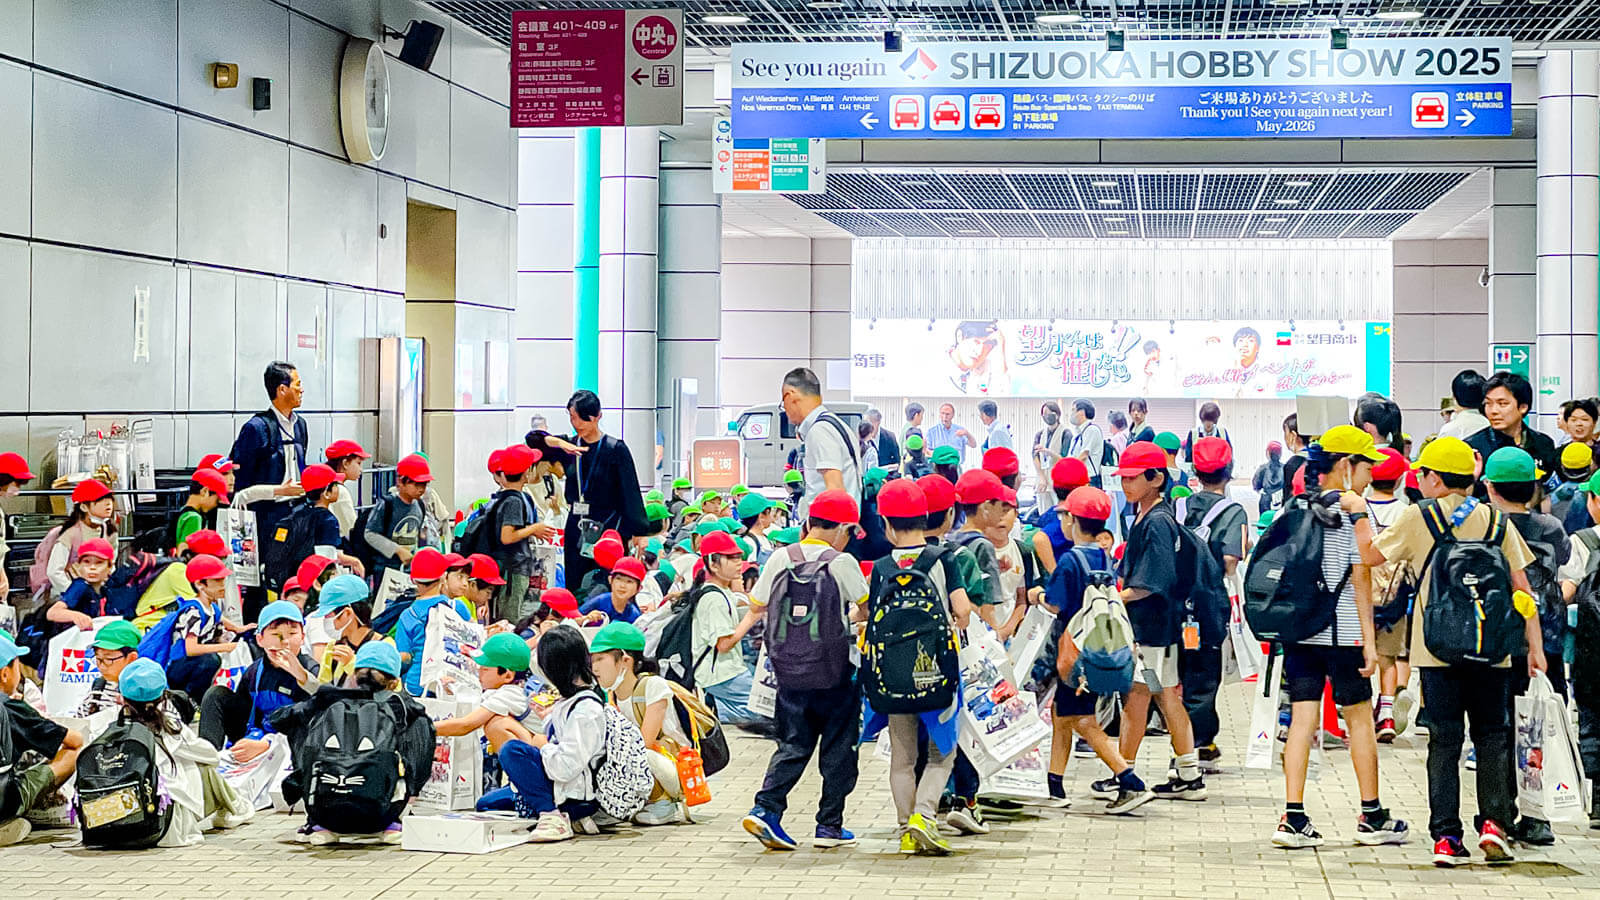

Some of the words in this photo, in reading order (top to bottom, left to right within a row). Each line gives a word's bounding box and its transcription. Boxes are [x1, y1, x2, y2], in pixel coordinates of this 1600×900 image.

[741, 57, 779, 77] See
[784, 62, 822, 81] you
[827, 58, 886, 81] again
[950, 51, 1141, 80] SHIZUOKA
[1150, 50, 1277, 79] HOBBY
[1287, 48, 1406, 77] SHOW
[1414, 47, 1500, 76] 2025
[1198, 91, 1374, 105] ご来場ありがとうございました
[1180, 106, 1218, 118] Thank
[1250, 106, 1271, 118] See
[1273, 108, 1295, 120] you
[1297, 106, 1330, 119] again
[1332, 107, 1358, 117] next
[1256, 120, 1315, 134] May.2026
[854, 353, 886, 369] 商事
